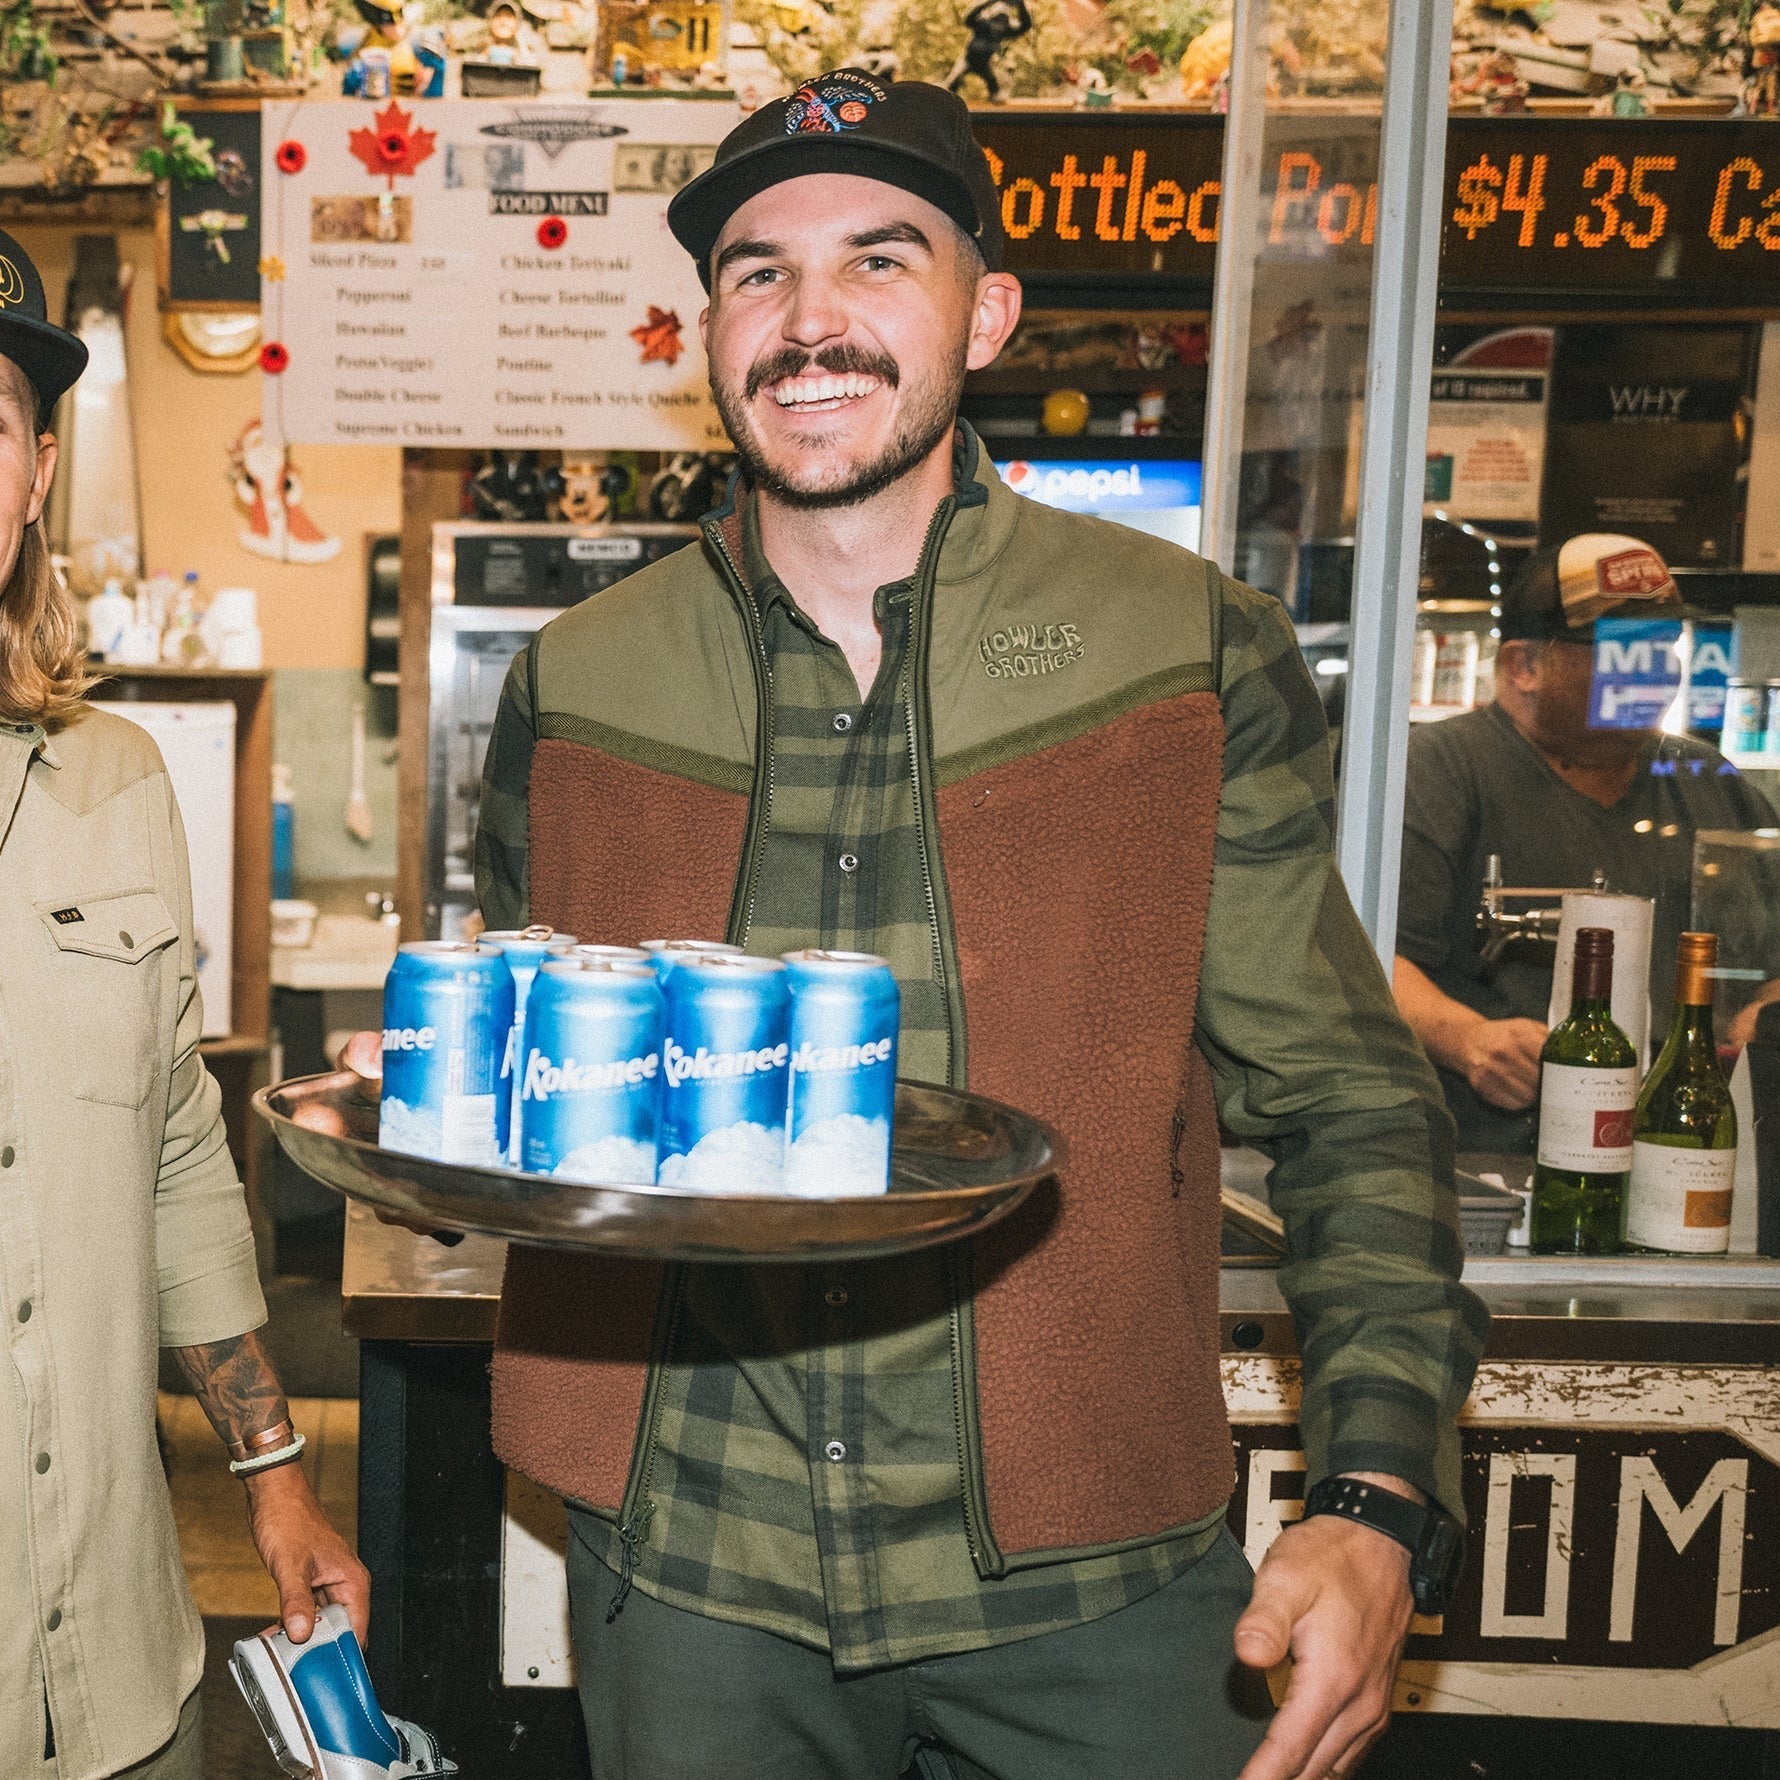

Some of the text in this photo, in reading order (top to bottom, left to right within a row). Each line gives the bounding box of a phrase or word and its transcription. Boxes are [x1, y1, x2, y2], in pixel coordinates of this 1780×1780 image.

[834, 72, 887, 102] BROTHERS
[492, 193, 607, 215] FOOD MENU
[1453, 153, 1677, 248] $4.35
[500, 256, 632, 274] Chicken Teriyaki
[336, 288, 412, 305] Pepperoni
[499, 289, 626, 304] Cheese Tortellini
[335, 322, 406, 336] Hawaiian
[498, 324, 607, 341] Beef Barbeque
[496, 357, 552, 371] Poutine
[334, 388, 442, 402] Double Cheese
[494, 390, 547, 405] Classic
[551, 390, 602, 405] French
[607, 390, 643, 407] Style
[648, 390, 700, 408] Quiche
[1609, 385, 1690, 414] WHY
[335, 422, 463, 437] Supreme Chicken
[494, 423, 564, 437] Sandwich
[1045, 464, 1143, 502] pepsi
[978, 623, 1081, 662] HOWLER
[663, 1037, 788, 1088] Kokanee
[522, 1047, 659, 1101] Kokanee
[1244, 1449, 1748, 1645] OM
